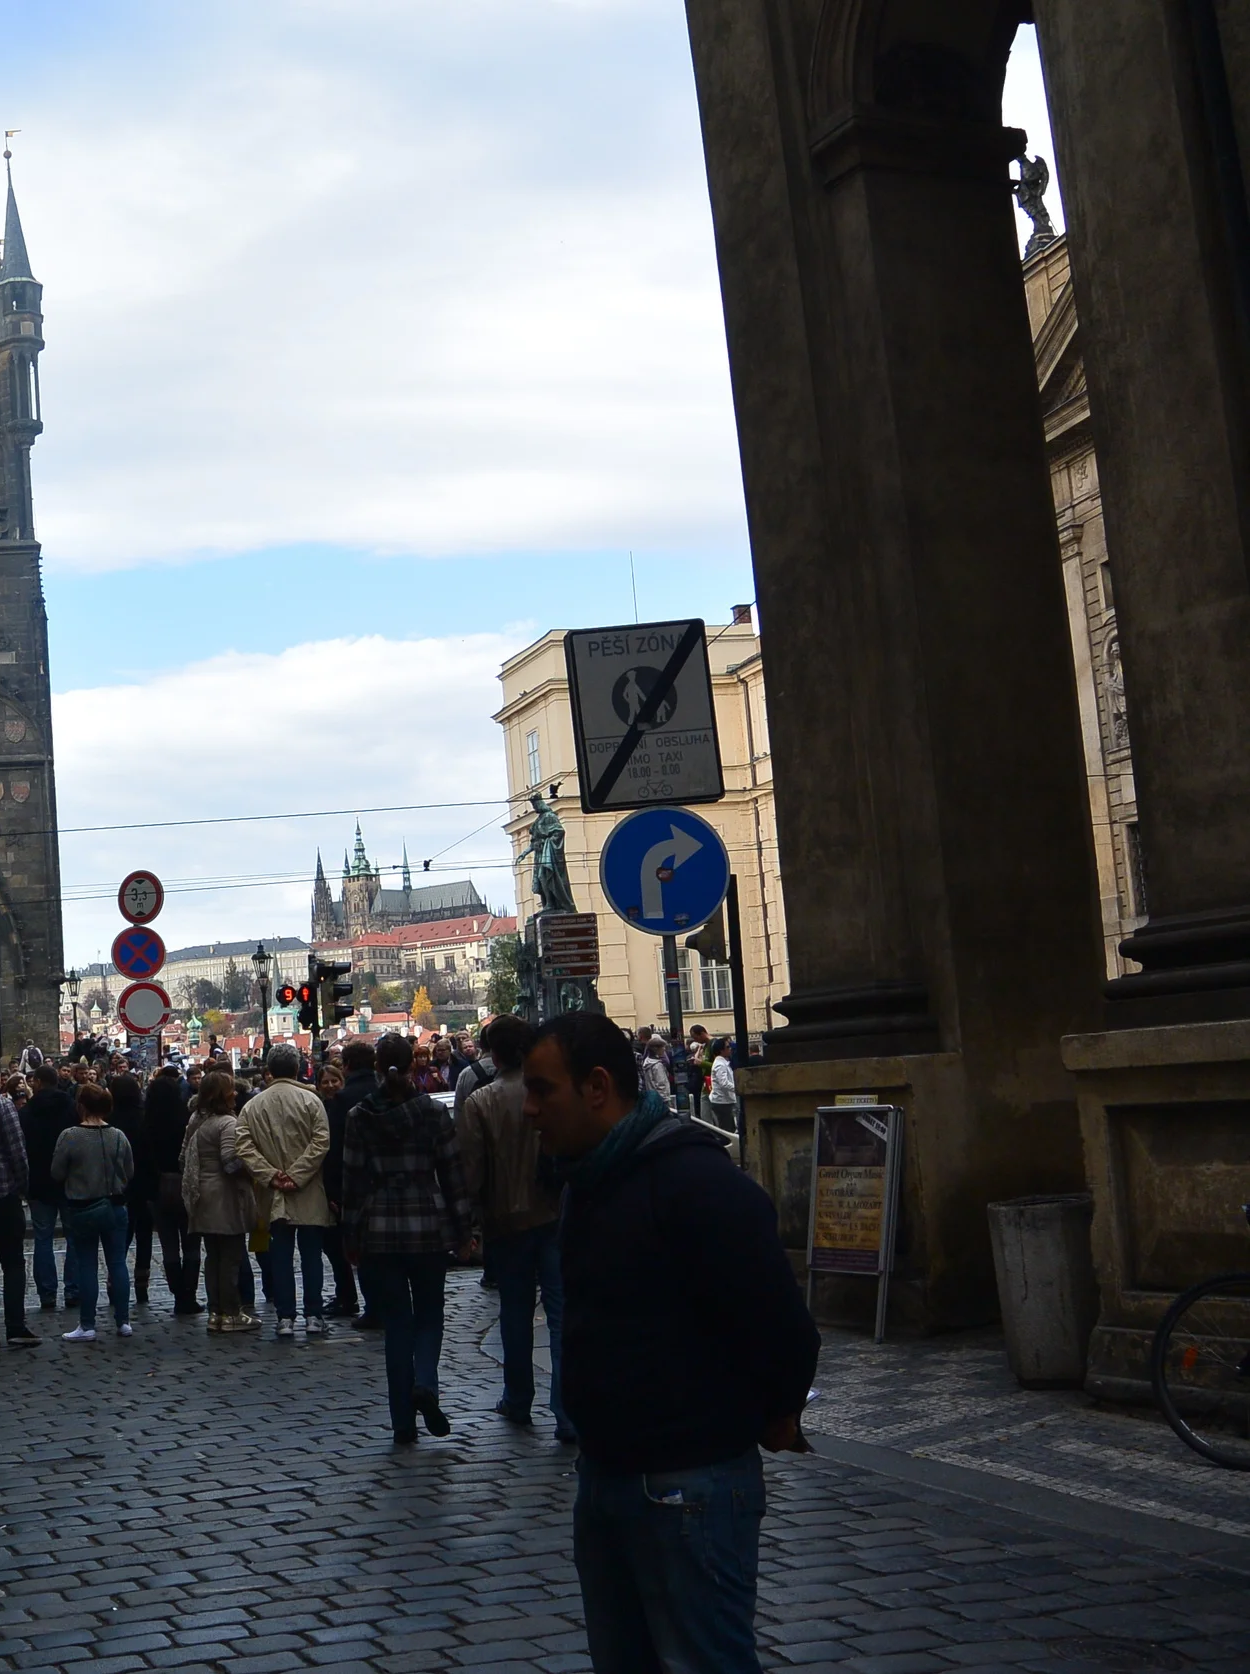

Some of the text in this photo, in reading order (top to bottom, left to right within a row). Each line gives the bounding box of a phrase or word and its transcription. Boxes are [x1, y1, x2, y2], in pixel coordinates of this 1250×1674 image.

[588, 633, 631, 658] PĚŠÍ
[589, 734, 711, 755] DOPRNÍ OBSLUHA
[658, 751, 684, 763] TAXI
[136, 901, 144, 909] m
[285, 989, 292, 1001] 9
[819, 1168, 839, 1178] Great
[841, 1168, 862, 1181] Organ
